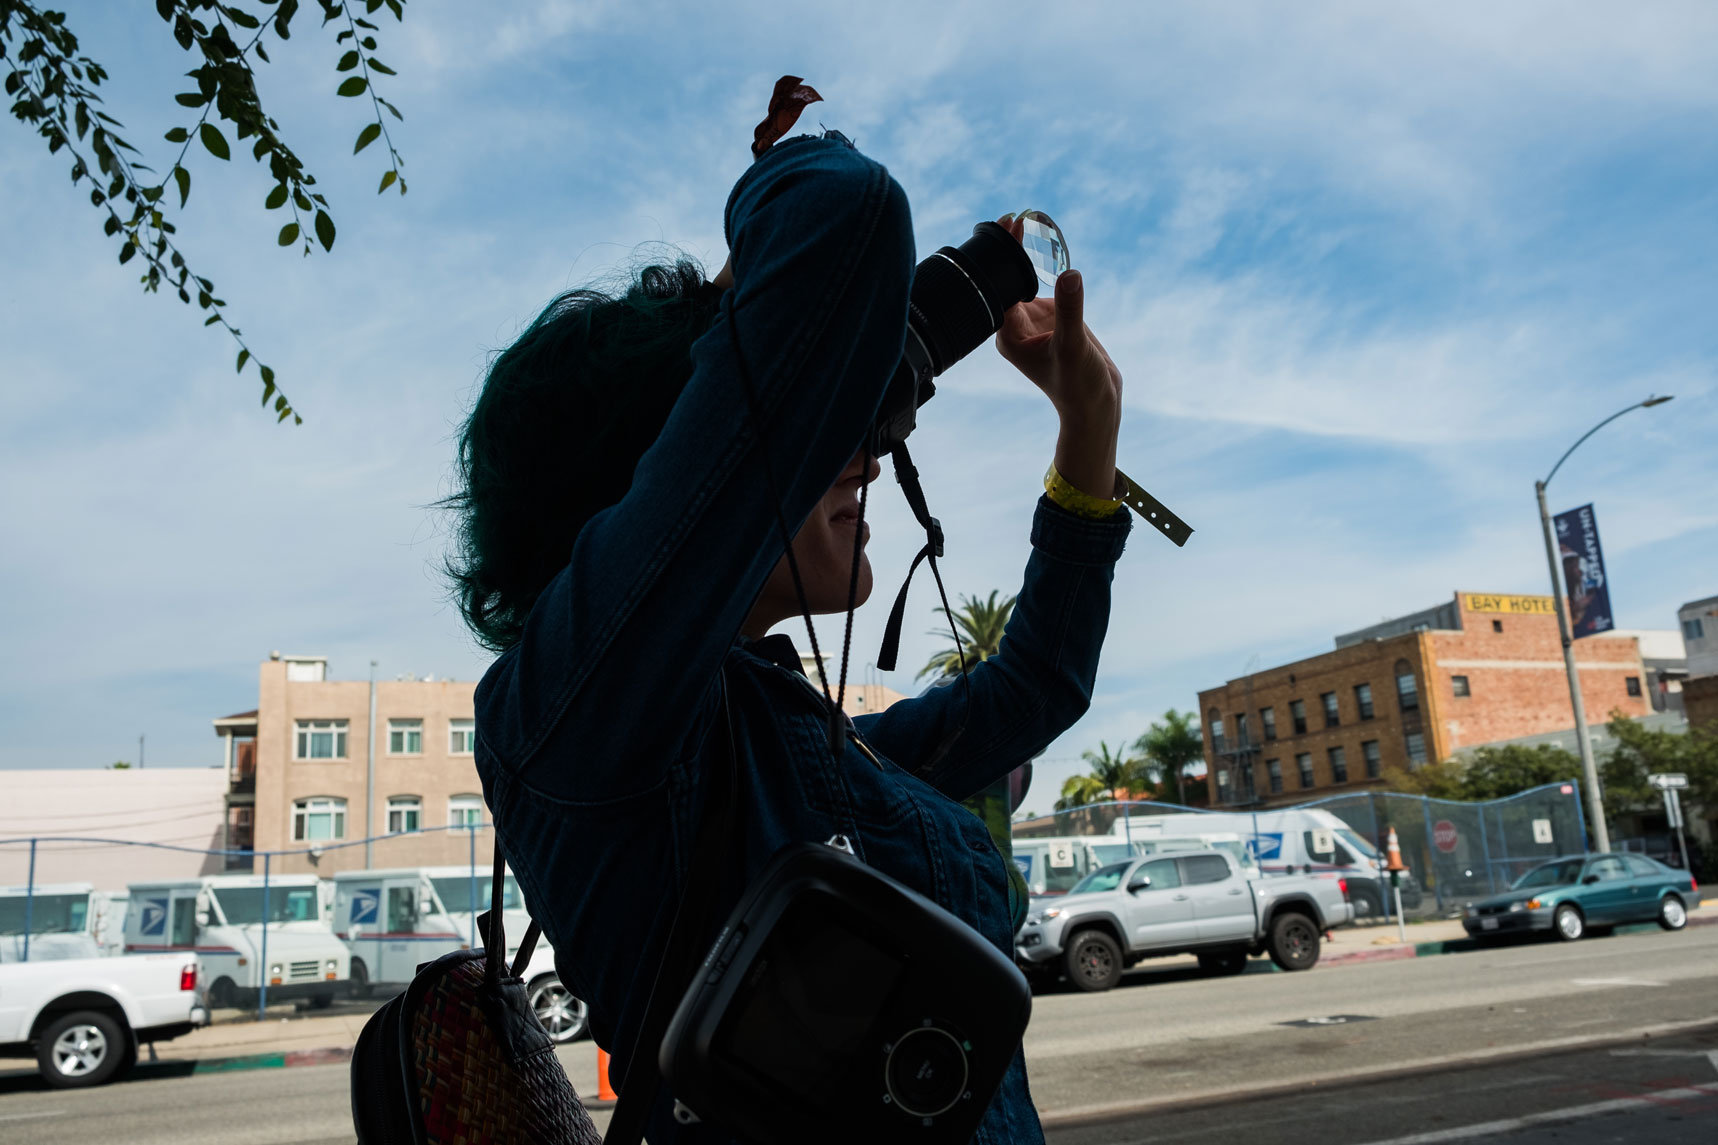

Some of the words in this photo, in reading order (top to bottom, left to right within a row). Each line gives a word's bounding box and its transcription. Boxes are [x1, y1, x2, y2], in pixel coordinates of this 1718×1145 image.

[1472, 596, 1502, 610] BAY
[1434, 829, 1457, 842] STOP
[1056, 849, 1066, 860] C
